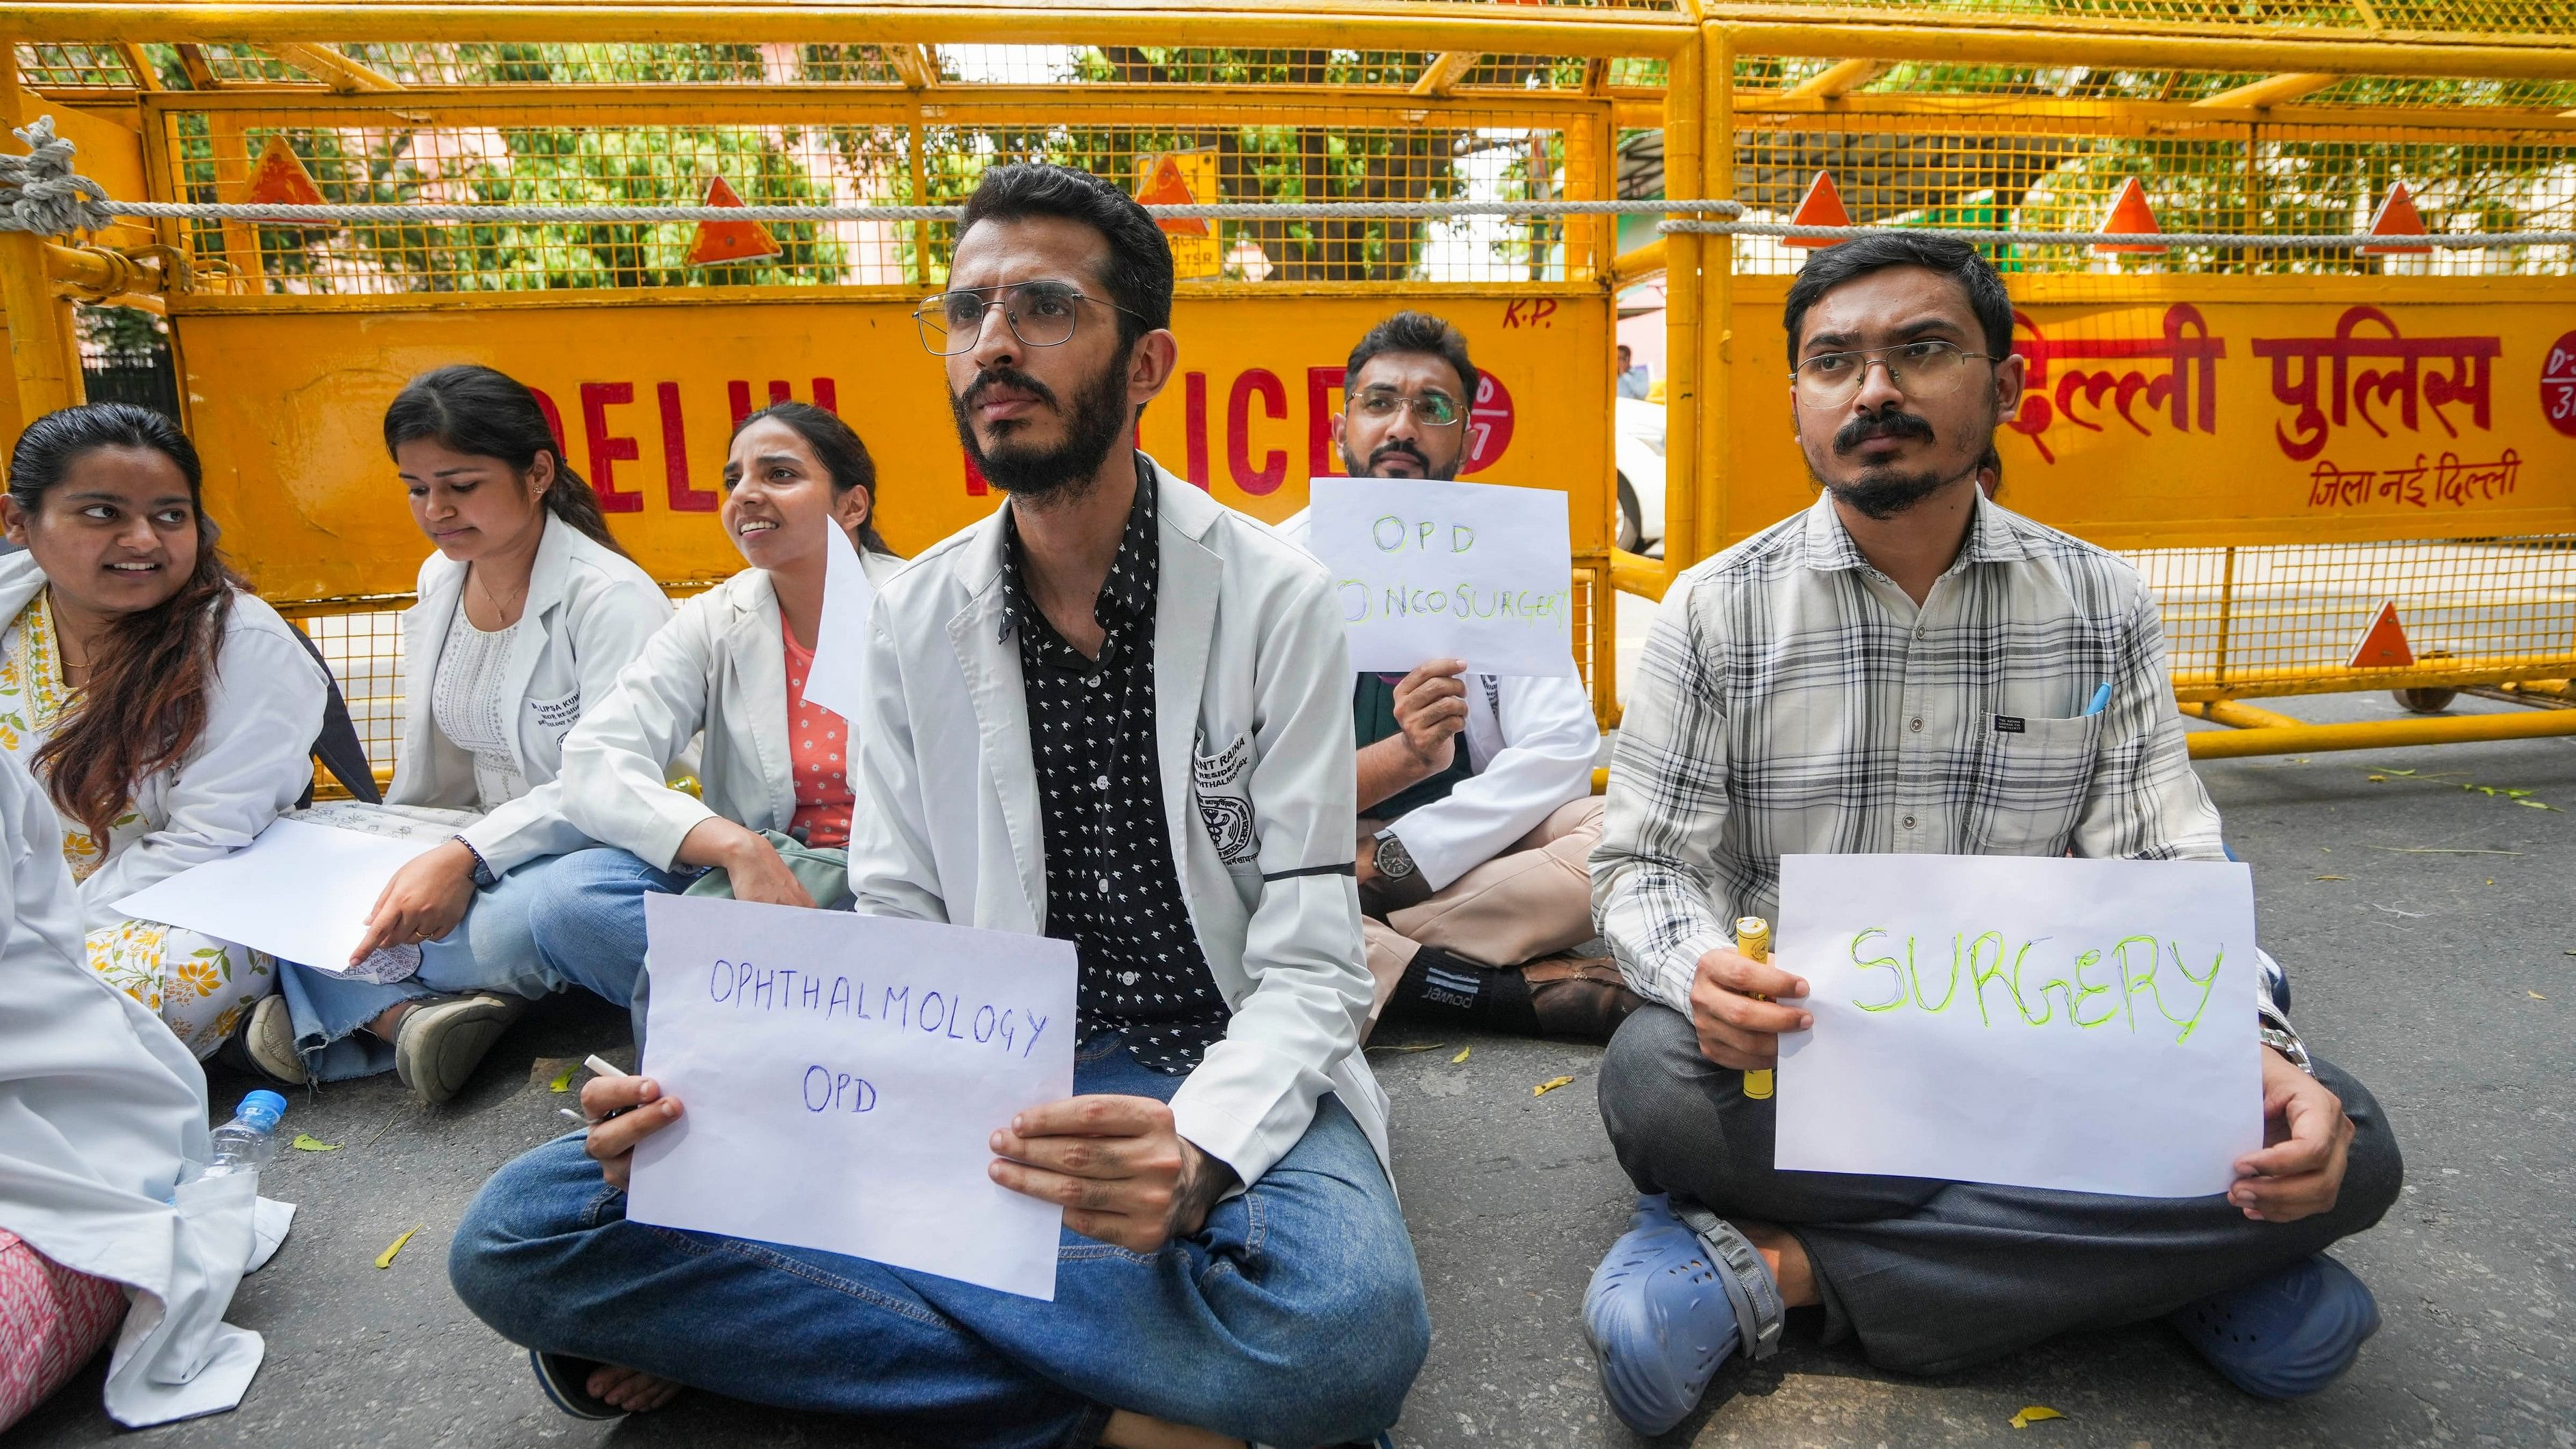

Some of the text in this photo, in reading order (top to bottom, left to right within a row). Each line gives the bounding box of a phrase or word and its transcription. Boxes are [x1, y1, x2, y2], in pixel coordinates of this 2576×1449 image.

[2252, 305, 2502, 462] पुलिस
[2308, 448, 2522, 507] जिला नई दिल्ली
[1372, 514, 1476, 554] OPD
[1199, 756, 1238, 779] RESIDENT
[1219, 737, 1245, 767] RAINA
[710, 959, 1049, 1058] OPHTHALMOLOGY
[1850, 927, 2224, 1046] SURGERY
[804, 1065, 877, 1114] OPD
